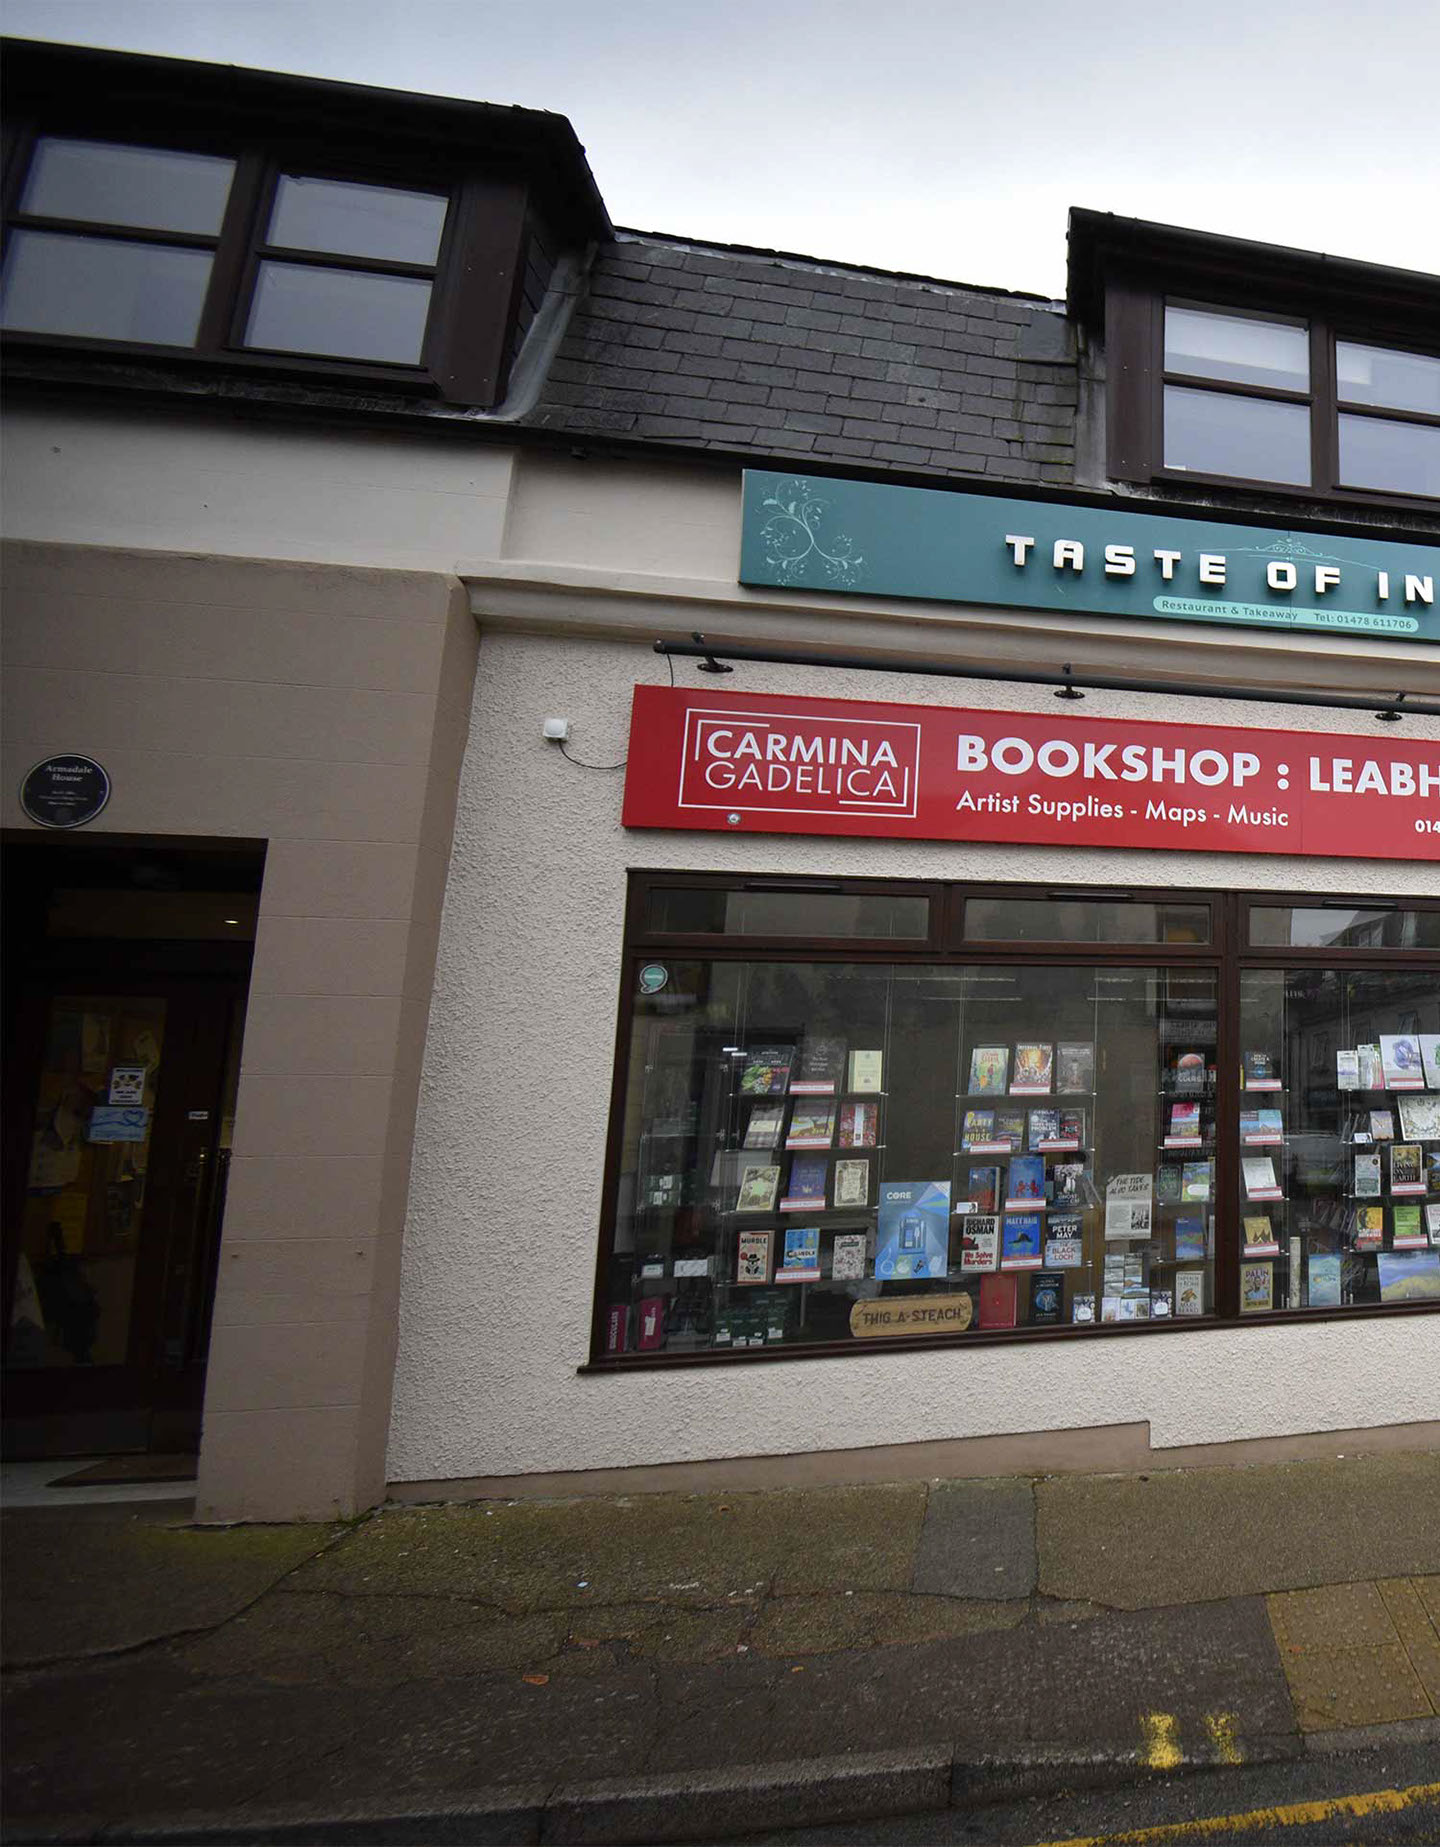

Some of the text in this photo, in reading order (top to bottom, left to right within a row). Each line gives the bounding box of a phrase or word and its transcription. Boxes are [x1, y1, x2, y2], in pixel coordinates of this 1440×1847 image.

[1005, 533, 1227, 585] TASTE
[1266, 560, 1341, 594] OF
[1160, 599, 1413, 630] Restaurant & Takeaway Tel: 01478 611706
[706, 730, 899, 769] CARMINA
[956, 734, 1261, 788] BOOKSHOP
[1277, 763, 1290, 791] :
[45, 765, 94, 775] Armadale
[52, 773, 84, 782] House
[704, 760, 898, 799] GADELICA
[955, 789, 1020, 814] Artist
[1028, 793, 1124, 823] Supplies
[1145, 800, 1207, 828] Maps
[1227, 803, 1289, 828] Music
[886, 1191, 912, 1200] CORE
[966, 1217, 996, 1226] RICHARD
[966, 1225, 995, 1235] OSMAN
[1052, 1224, 1078, 1233] PETER
[1056, 1231, 1074, 1239] MAY
[741, 1237, 768, 1245] MURDLE
[1052, 1245, 1076, 1254] BLACK
[1054, 1253, 1074, 1261] LOCH
